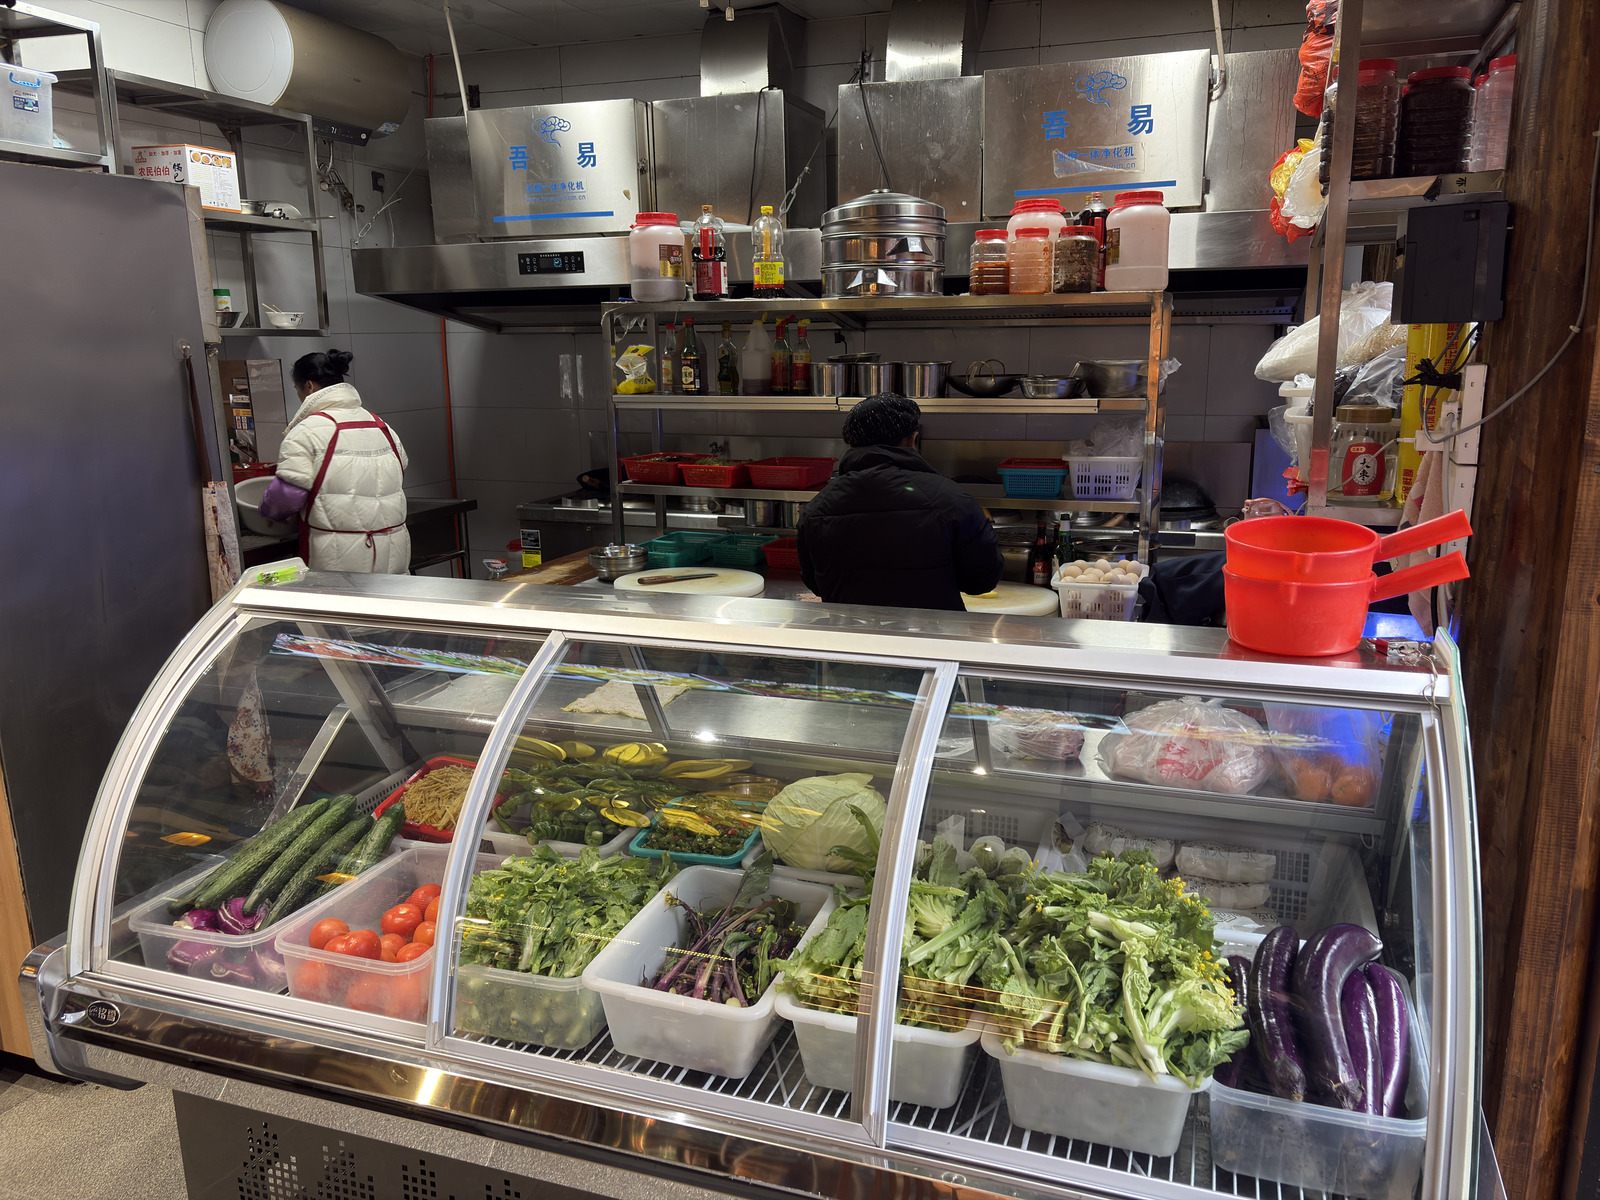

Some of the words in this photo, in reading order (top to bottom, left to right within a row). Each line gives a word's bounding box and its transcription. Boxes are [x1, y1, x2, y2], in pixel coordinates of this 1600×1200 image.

[1041, 110, 1070, 141] 吾
[1127, 104, 1154, 136] 易
[508, 145, 530, 171] 吾
[576, 142, 597, 168] 易
[1056, 146, 1135, 162] 油烟一体净化机
[138, 165, 170, 178] 农民伯伯
[526, 180, 585, 193] 油烟一体净化机
[1358, 458, 1371, 482] 大枣
